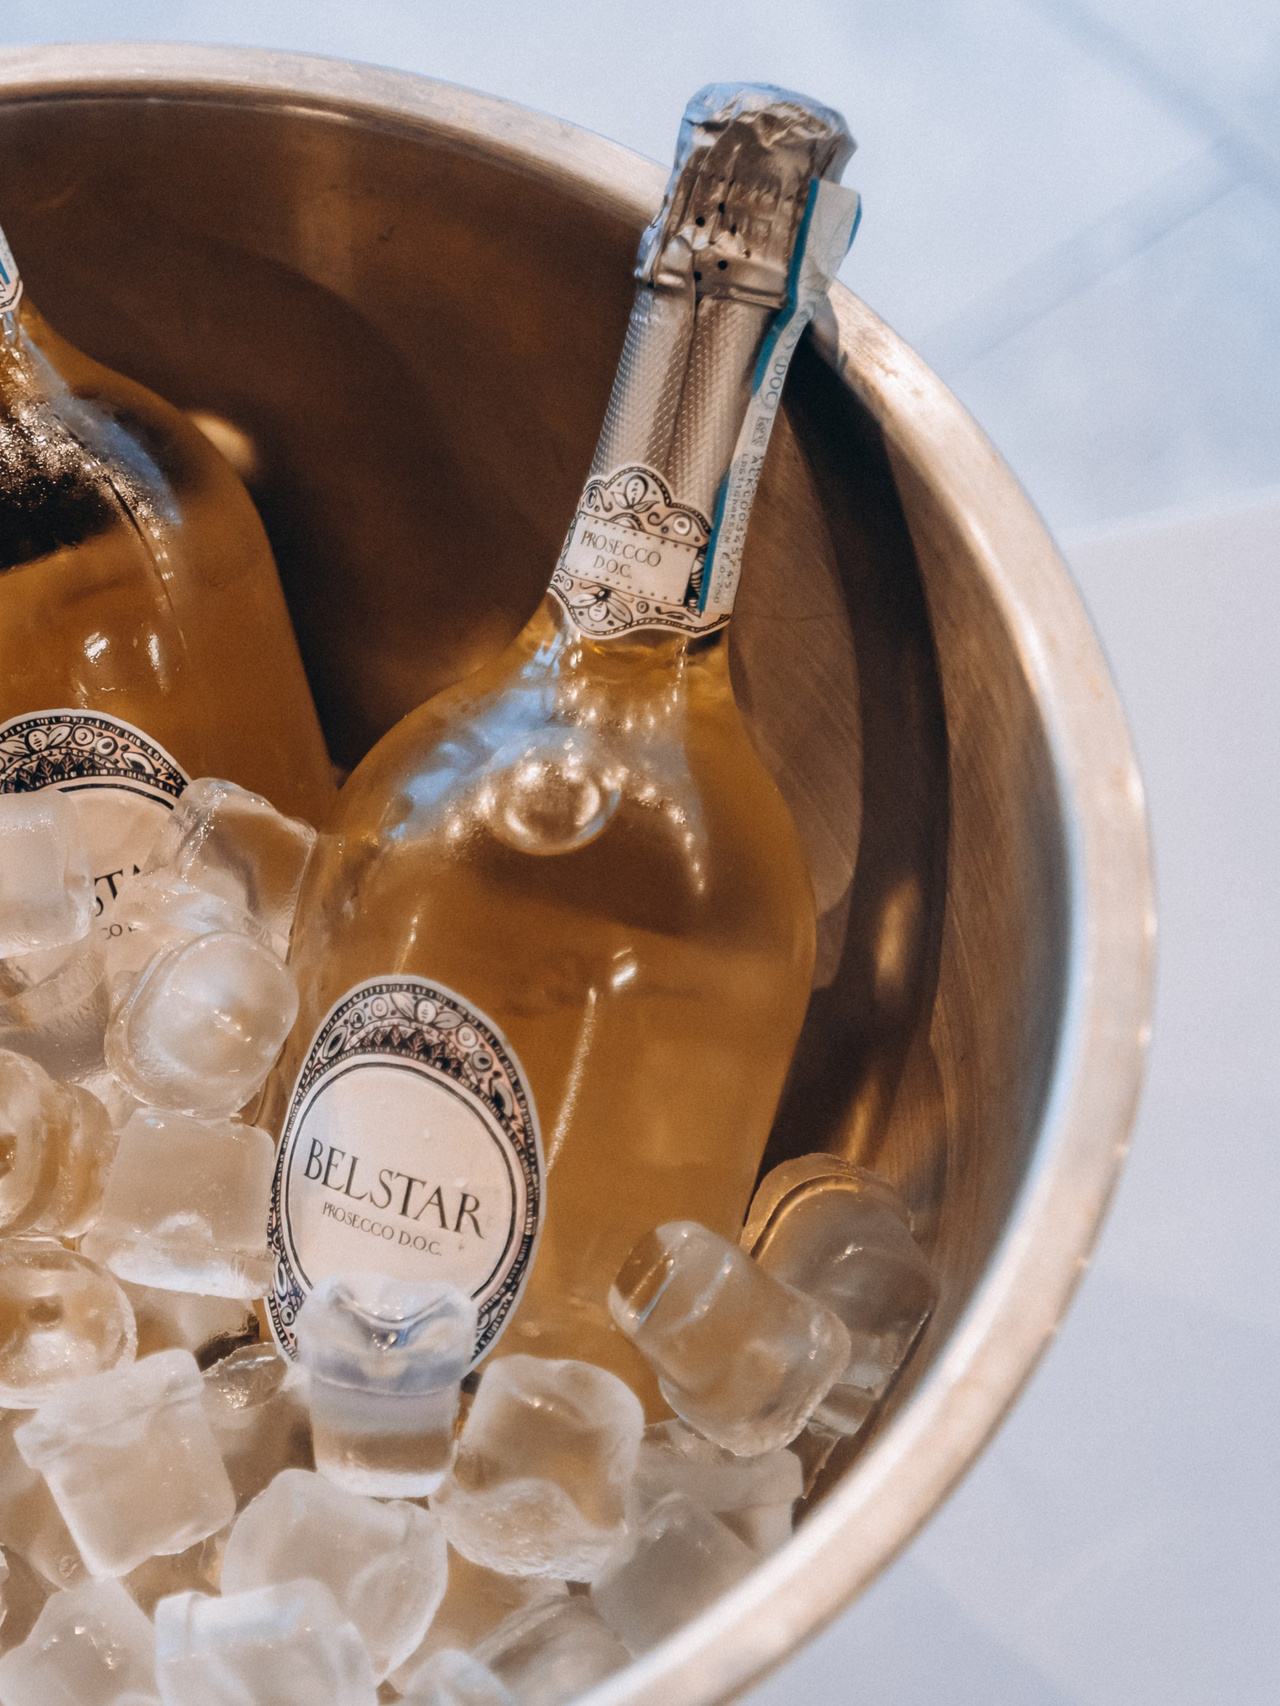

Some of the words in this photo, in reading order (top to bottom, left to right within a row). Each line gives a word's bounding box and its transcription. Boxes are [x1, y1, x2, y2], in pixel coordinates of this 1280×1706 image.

[765, 363, 787, 401] DOC
[580, 529, 662, 568] PROSECCO
[593, 555, 633, 580] D.O.C.
[303, 1136, 486, 1241] BELSTAR
[321, 1201, 395, 1242] PROSECCO
[397, 1230, 443, 1256] D.O.C.
